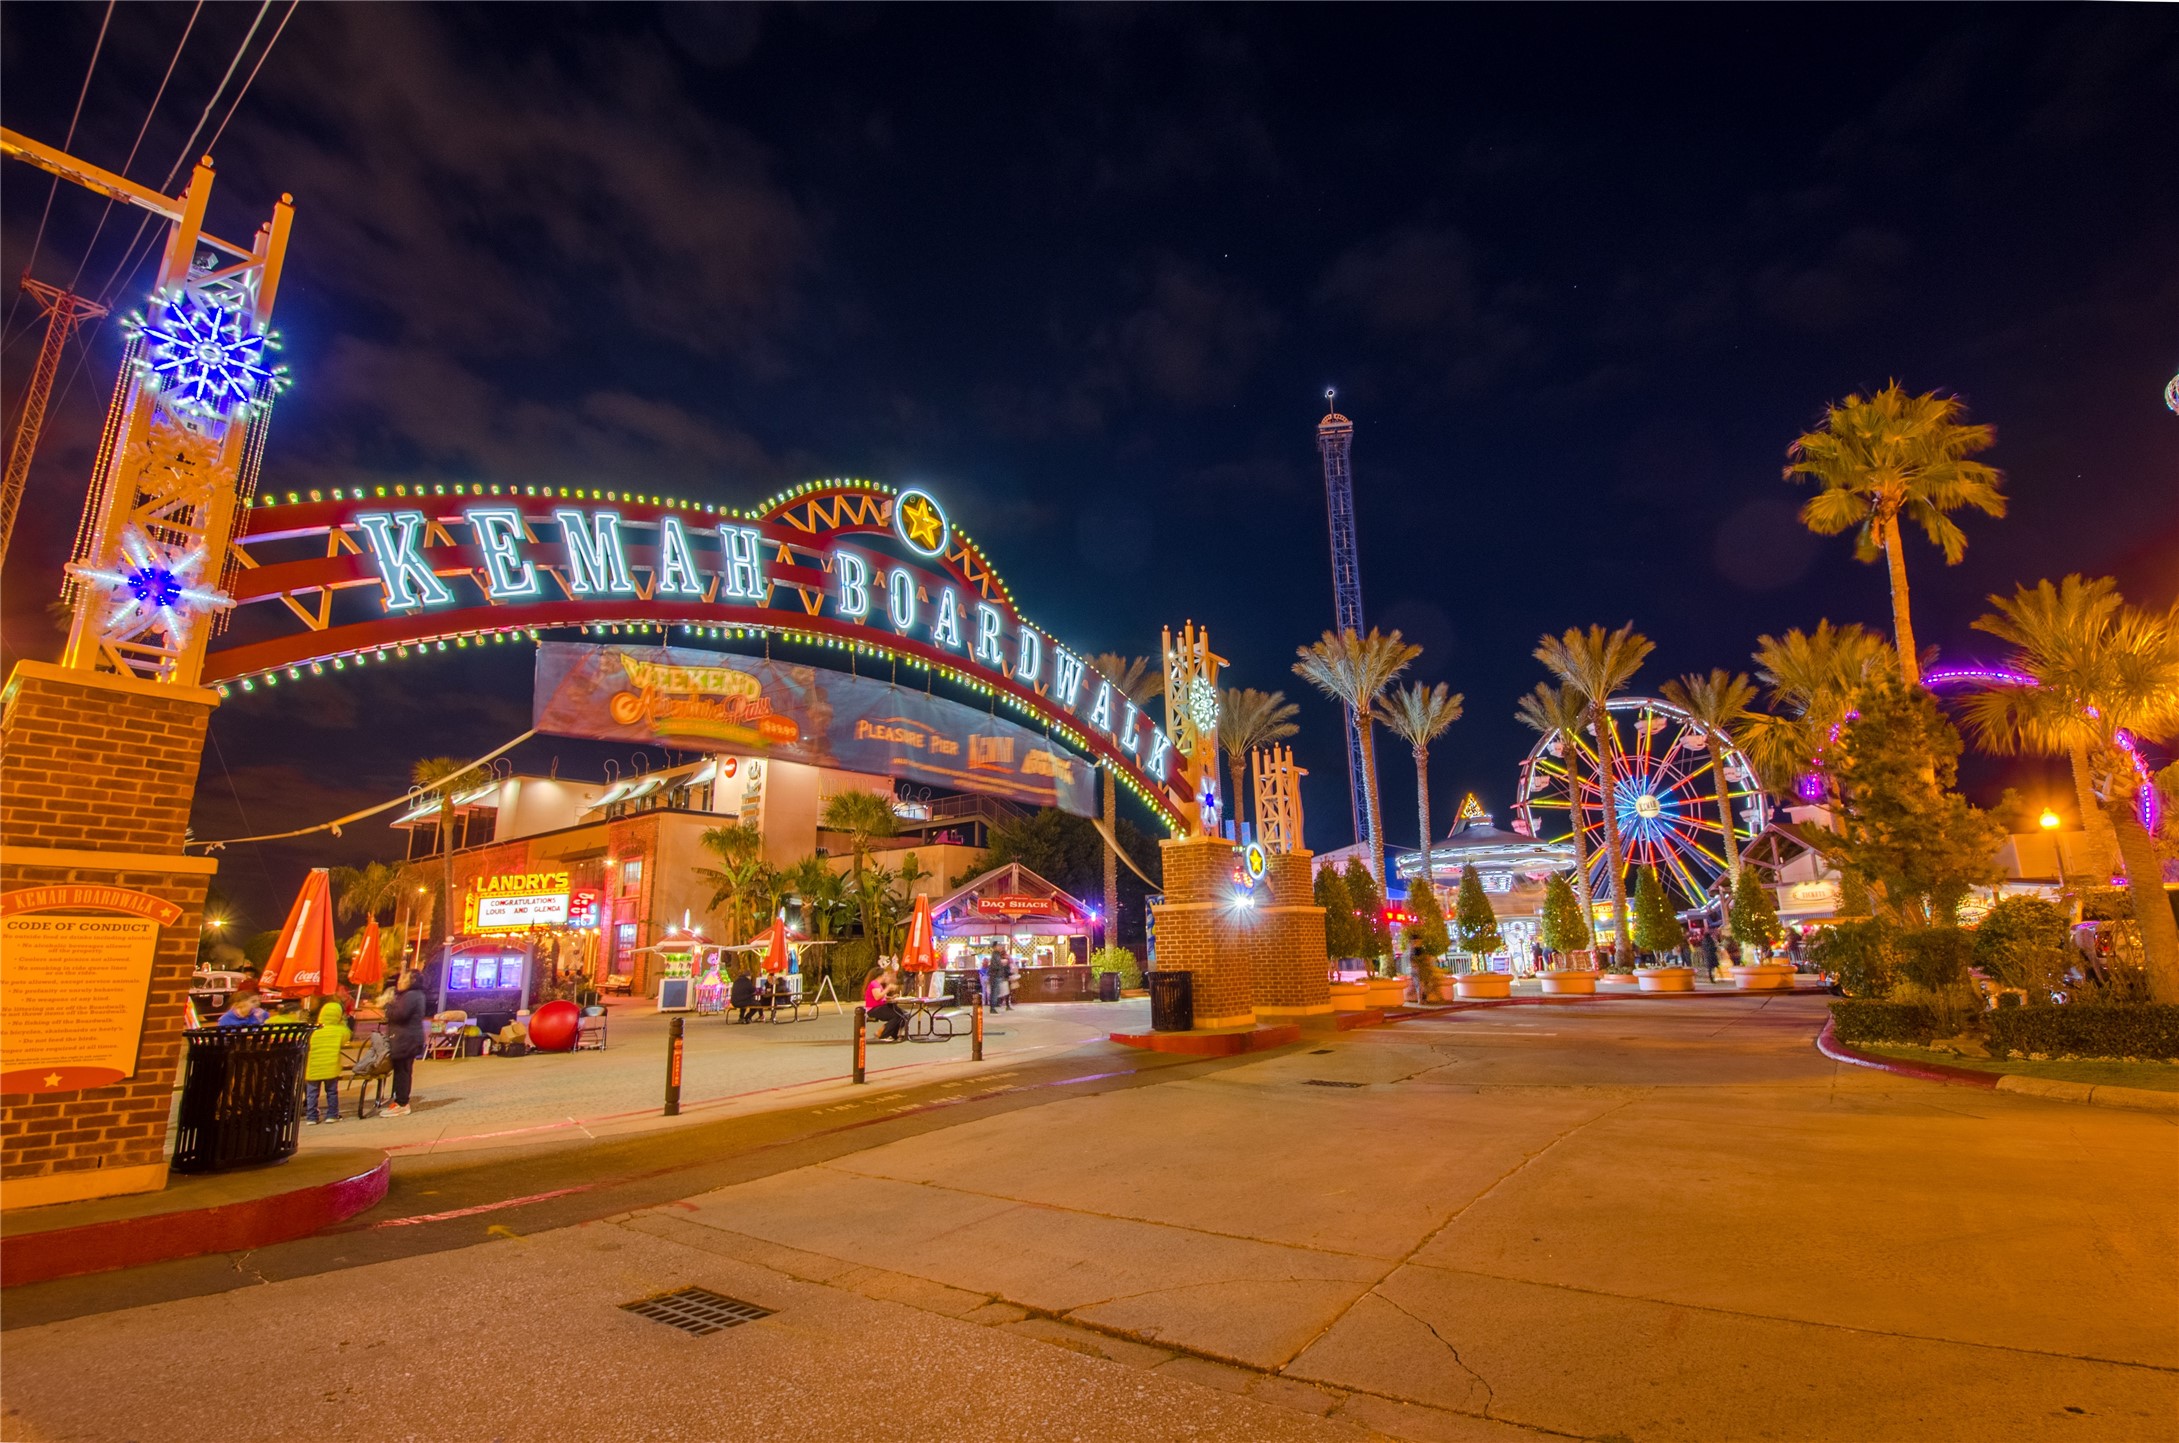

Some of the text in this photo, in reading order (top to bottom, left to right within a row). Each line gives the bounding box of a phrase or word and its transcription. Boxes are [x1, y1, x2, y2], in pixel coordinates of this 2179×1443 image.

[355, 508, 1171, 781] KEMAH BOARDWALK
[622, 656, 761, 702] WEEKEND
[855, 720, 927, 748] PLEASURE
[930, 735, 960, 755] PIER
[477, 872, 568, 892] LANDRY'S
[15, 889, 157, 914] KEMAH BOARDWALK
[490, 897, 556, 907] CONGRATULATIONS
[534, 905, 560, 913] GLENDA
[981, 901, 1005, 909] DAQ
[7, 921, 150, 932] CODE OF CONDUCT
